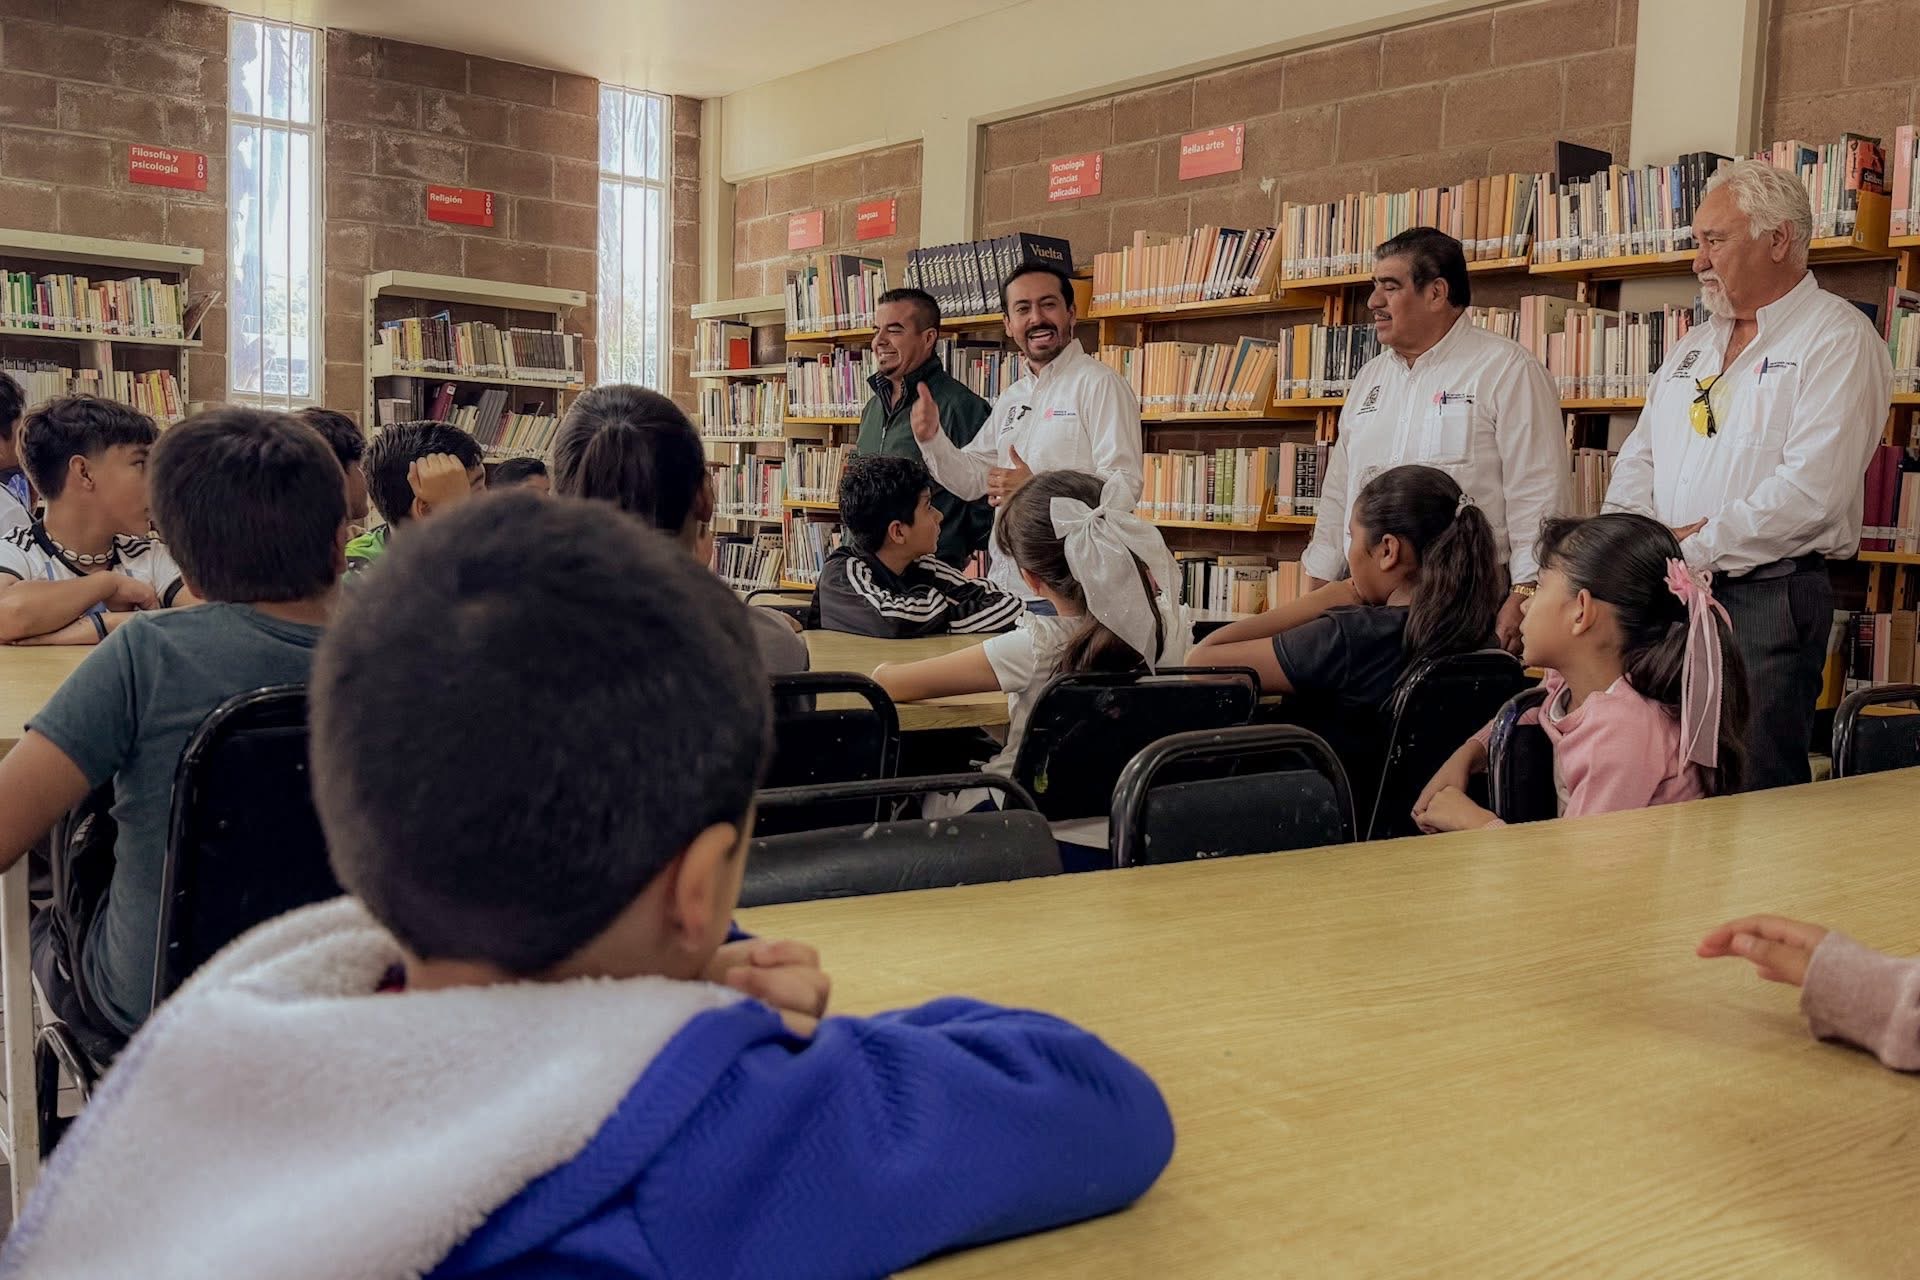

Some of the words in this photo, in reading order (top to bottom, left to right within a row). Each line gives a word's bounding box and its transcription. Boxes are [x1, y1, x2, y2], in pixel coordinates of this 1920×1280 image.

[131, 147, 171, 160] Filosofía
[172, 154, 179, 163] y
[1182, 144, 1204, 156] Bellas
[1205, 140, 1225, 151] artes
[131, 161, 178, 173] psicología
[1050, 173, 1079, 187] (Ciencias
[430, 193, 462, 204] Religión
[1049, 185, 1082, 200] aplicadas)
[1030, 243, 1063, 260] Vuelta
